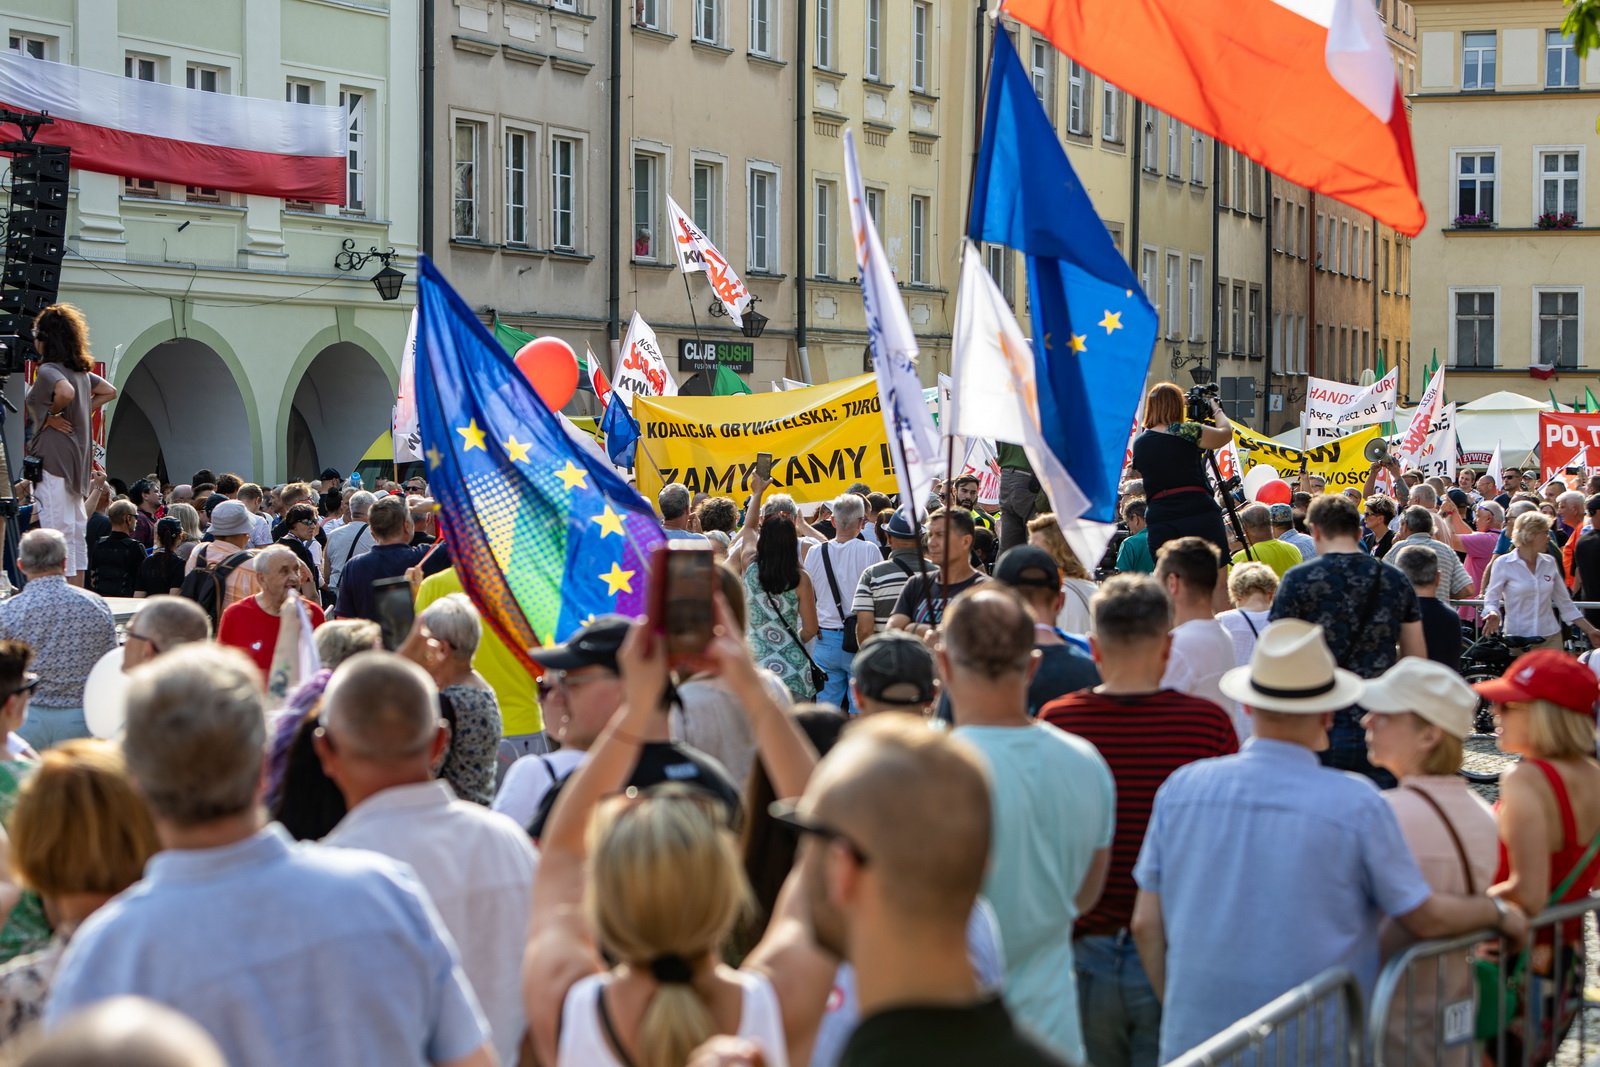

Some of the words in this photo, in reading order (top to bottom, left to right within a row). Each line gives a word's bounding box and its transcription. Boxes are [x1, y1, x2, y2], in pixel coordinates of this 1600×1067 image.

[637, 338, 661, 362] NSZZ
[684, 342, 716, 360] CLUB
[718, 343, 752, 362] SUSHI
[1309, 387, 1355, 405] HANDS
[1364, 403, 1378, 416] od
[647, 422, 716, 438] KOALICJA
[720, 409, 838, 438] OBYWATELSKA:
